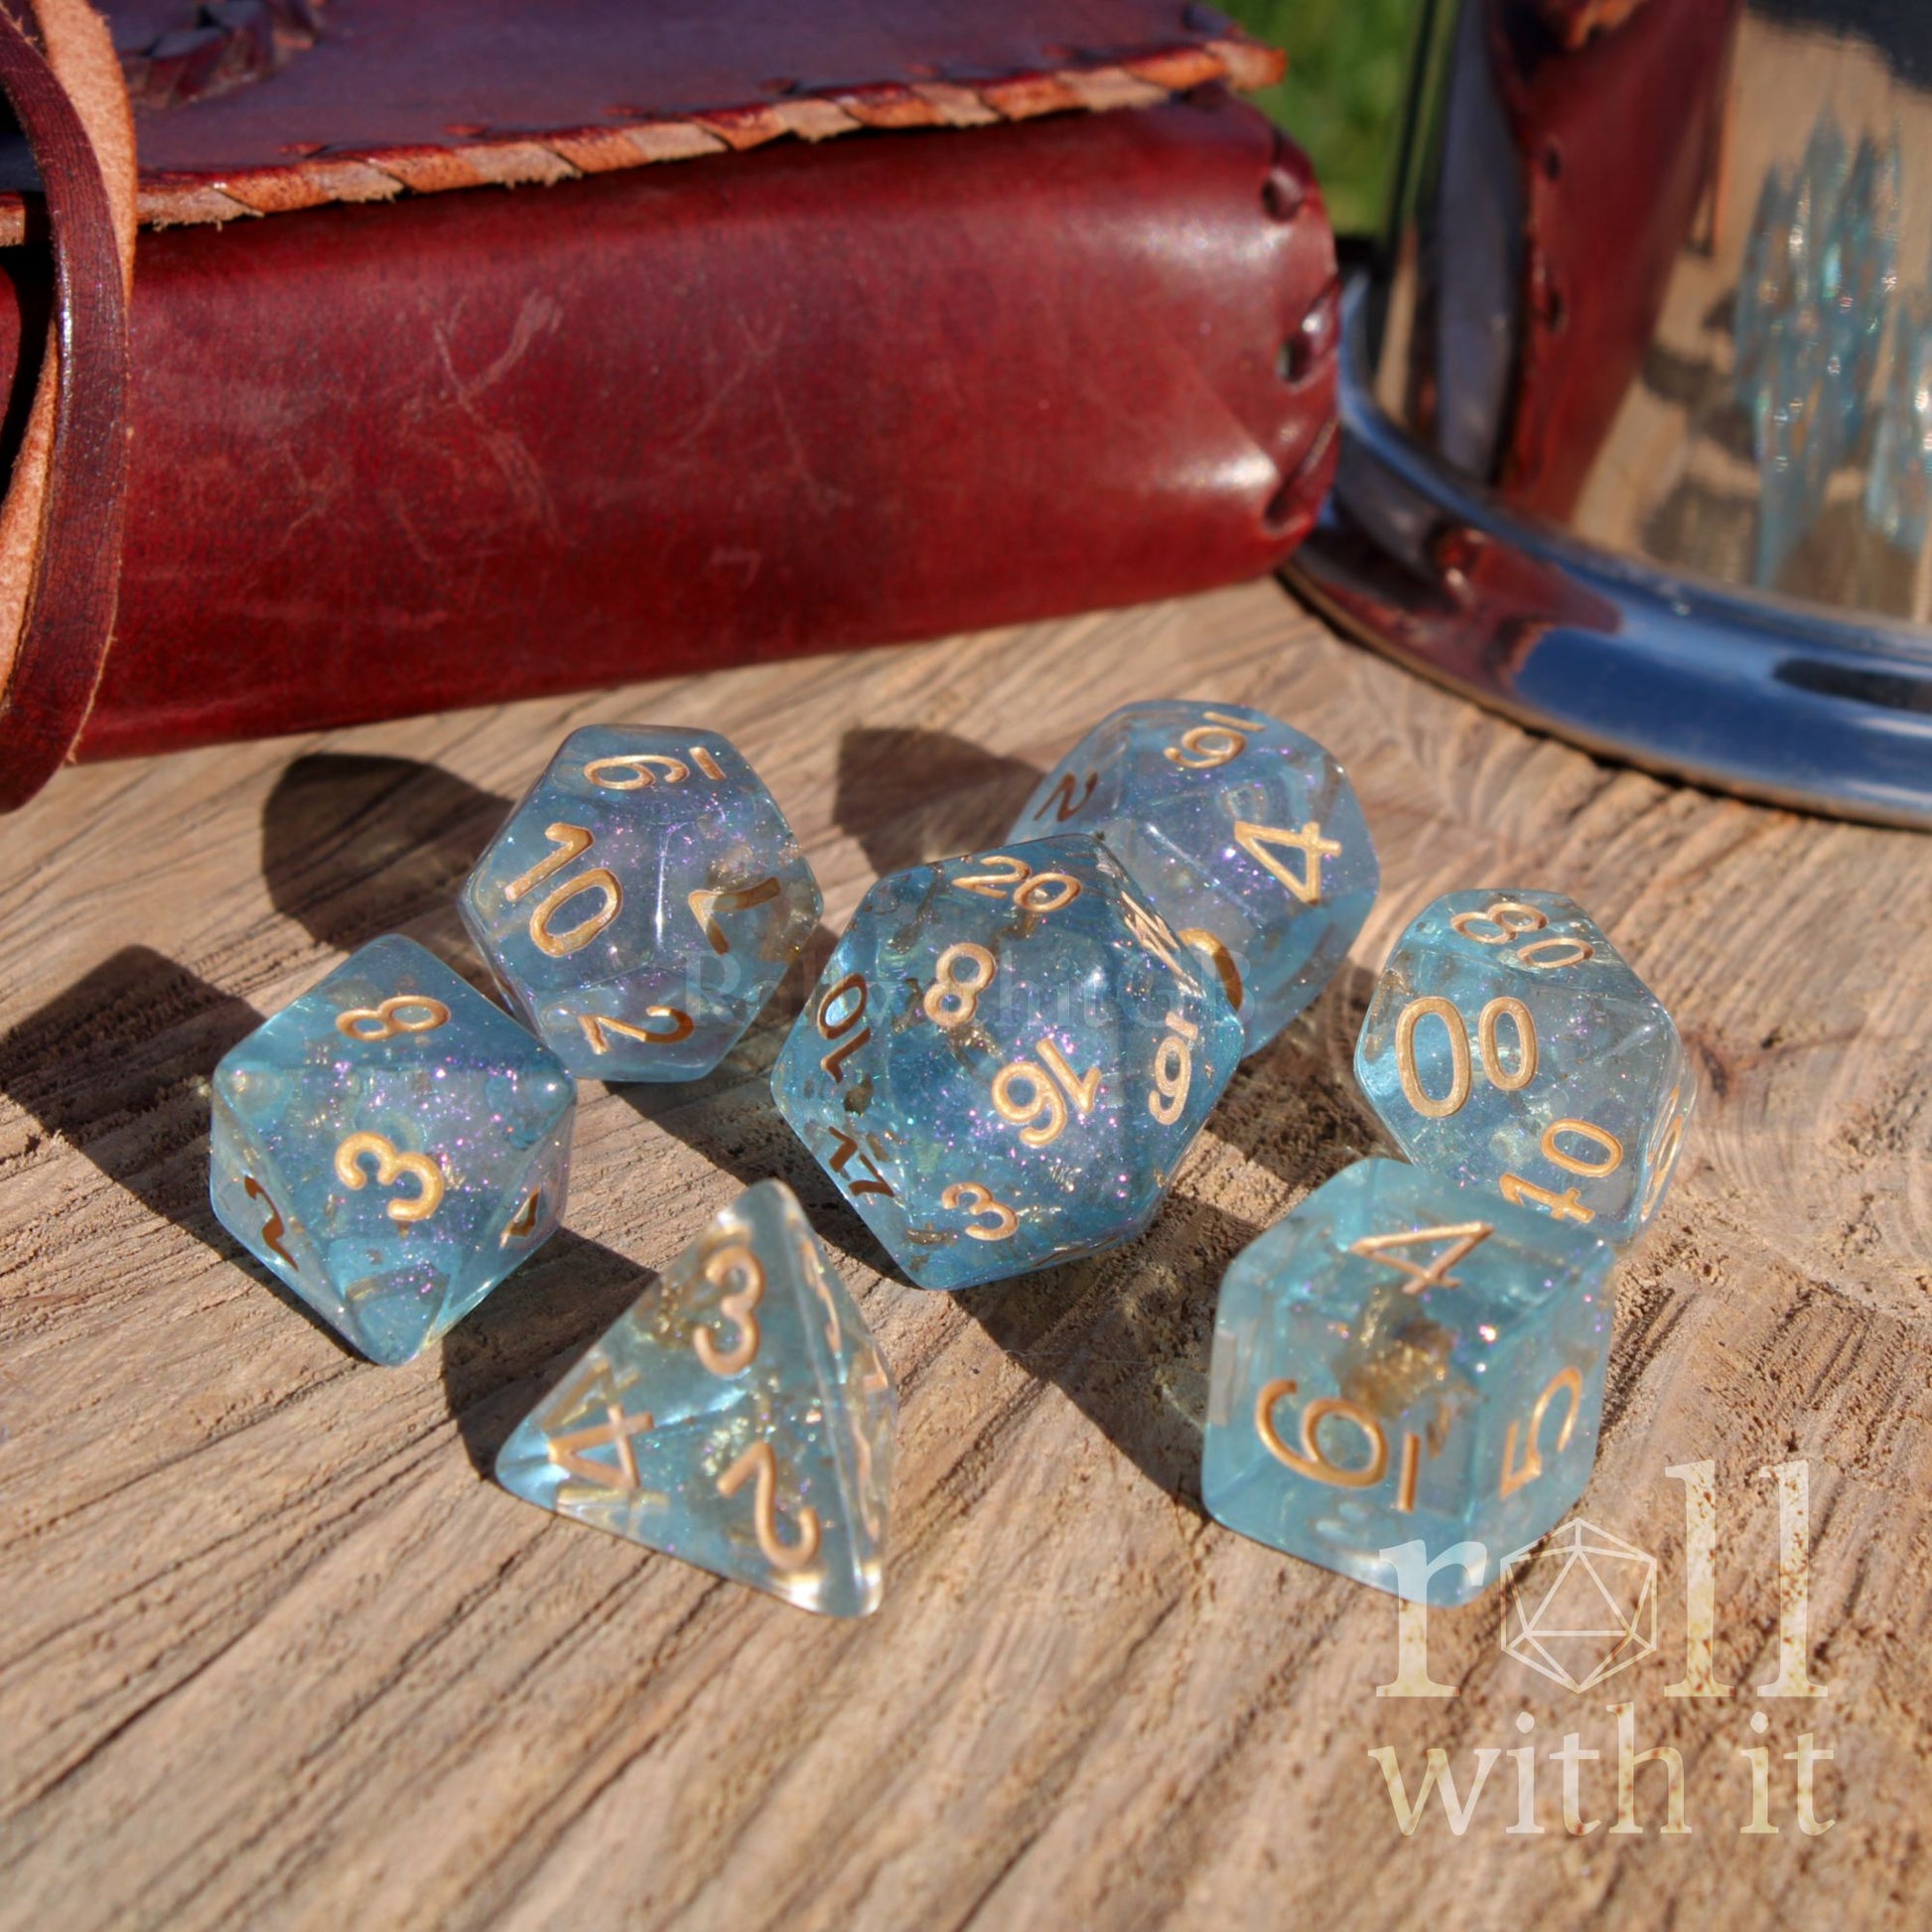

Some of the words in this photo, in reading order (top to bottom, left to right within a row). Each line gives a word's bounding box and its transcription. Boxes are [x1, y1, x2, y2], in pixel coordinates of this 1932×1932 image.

[504, 822, 623, 957] 10
[952, 855, 1082, 912] 20
[1234, 821, 1341, 905] 4
[1450, 901, 1594, 970] 80
[336, 995, 452, 1041] 8
[923, 942, 997, 1027] 8
[993, 1037, 1102, 1148] 16
[1395, 996, 1538, 1119] 00
[335, 1131, 446, 1221] 3
[942, 1181, 1020, 1241] 3
[1351, 1221, 1494, 1295] 4
[695, 1245, 767, 1376] 3
[547, 1403, 654, 1489] 4
[1500, 1367, 1583, 1499] 5
[717, 1440, 822, 1569] 2
